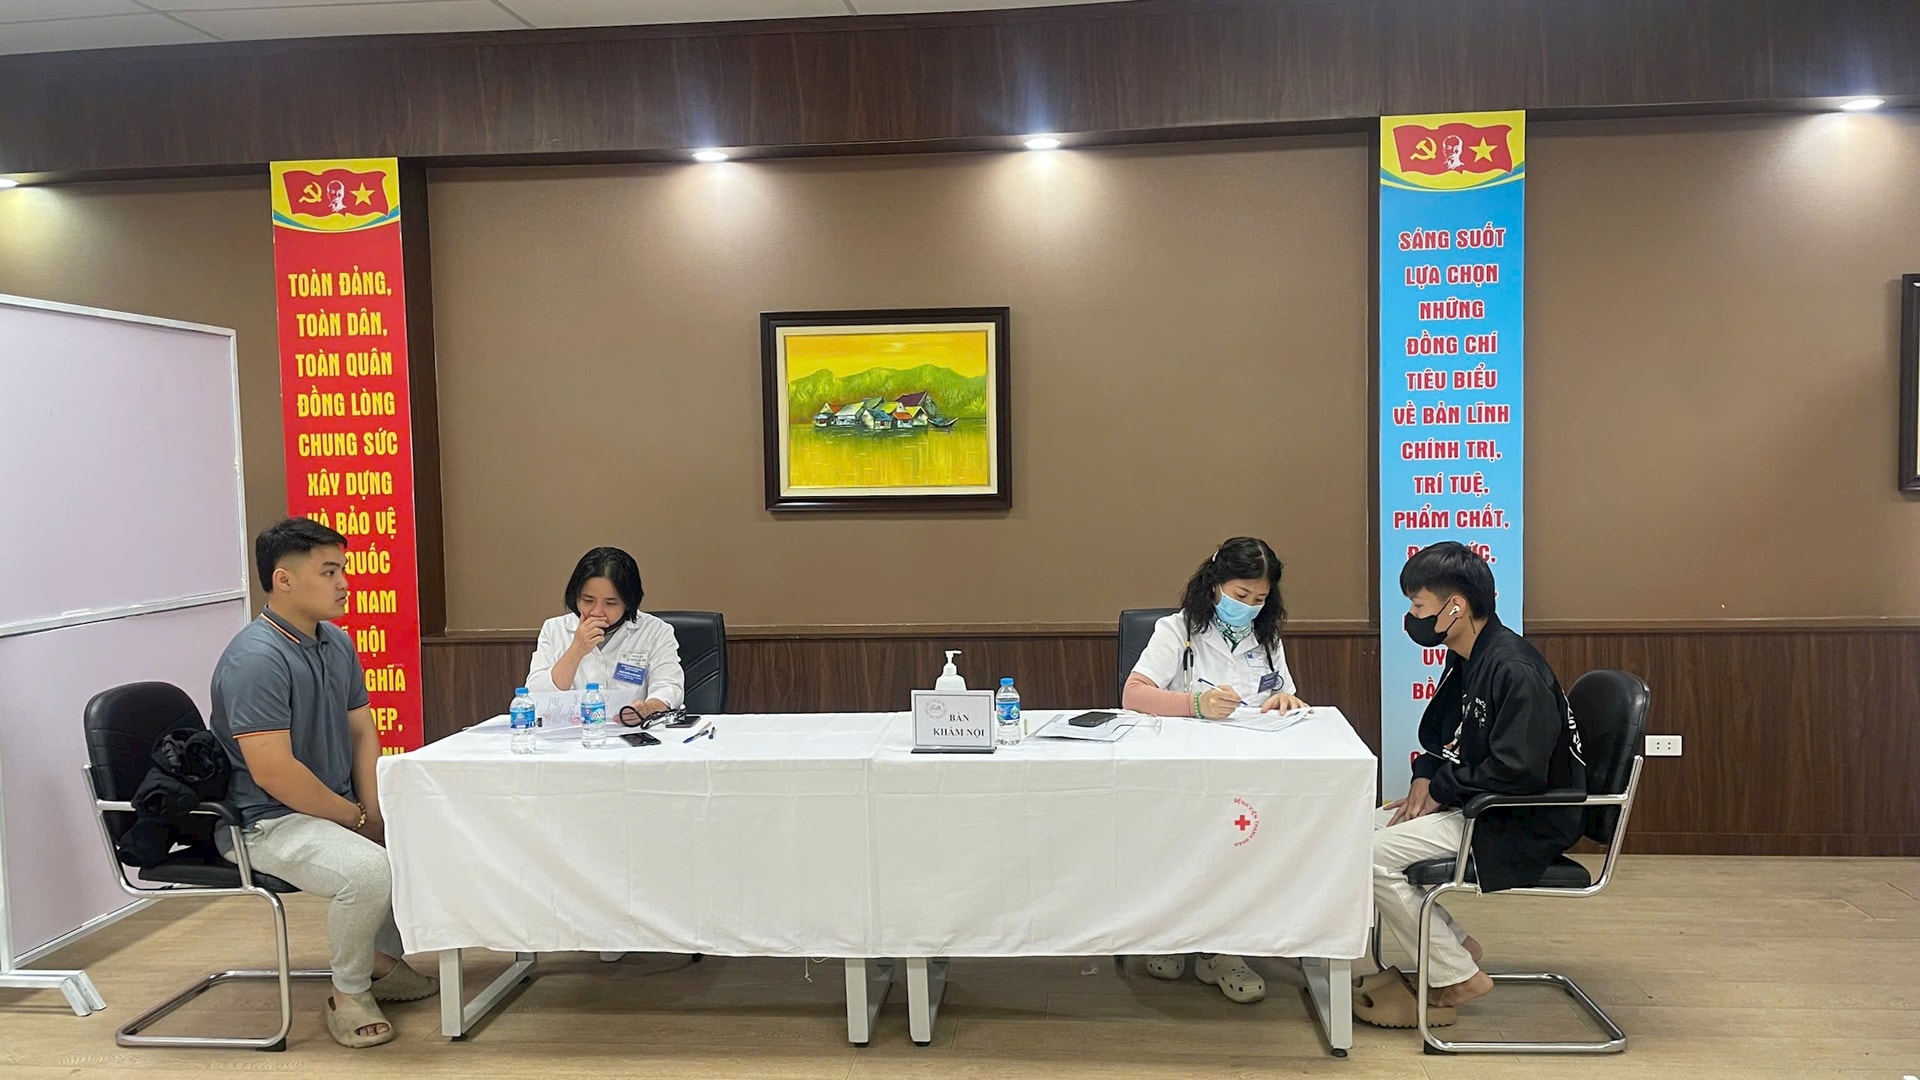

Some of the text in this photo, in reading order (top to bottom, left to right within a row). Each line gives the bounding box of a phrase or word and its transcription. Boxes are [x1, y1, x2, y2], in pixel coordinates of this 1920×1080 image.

[1399, 222, 1505, 251] SÁNG SUỐT
[288, 264, 392, 298] TOÀN ĐẢNG,
[1405, 264, 1499, 288] LỰA CHỌN
[296, 307, 388, 338] TOÀN DÂN,
[1419, 297, 1485, 321] NHỮNG
[1406, 331, 1498, 356] ĐỒNG CHÍ
[295, 347, 393, 378] TOÀN QUÂN
[1407, 363, 1498, 391] TIÊU BIỂU
[296, 384, 396, 418] ĐỒNG LÒNG
[1392, 401, 1511, 426] VỀ BẢN LĨNH
[298, 427, 398, 457] CHUNG SỨC
[1401, 439, 1502, 462] CHÍNH TRỊ,
[307, 468, 393, 500] XÂY DỰNG
[1413, 472, 1490, 497] TRÍ TUỆ,
[335, 504, 371, 536] BẢO
[375, 506, 397, 540] VỆ
[1393, 500, 1510, 530] PHẨM CHẤT,
[344, 542, 391, 576] QUỐC
[356, 589, 397, 614] NAM
[356, 624, 386, 658] HỘI
[364, 664, 406, 692] GHĨA
[1411, 676, 1436, 700] BẦ
[949, 712, 970, 722] BÀN
[933, 726, 985, 739] KHÁM NỘI
